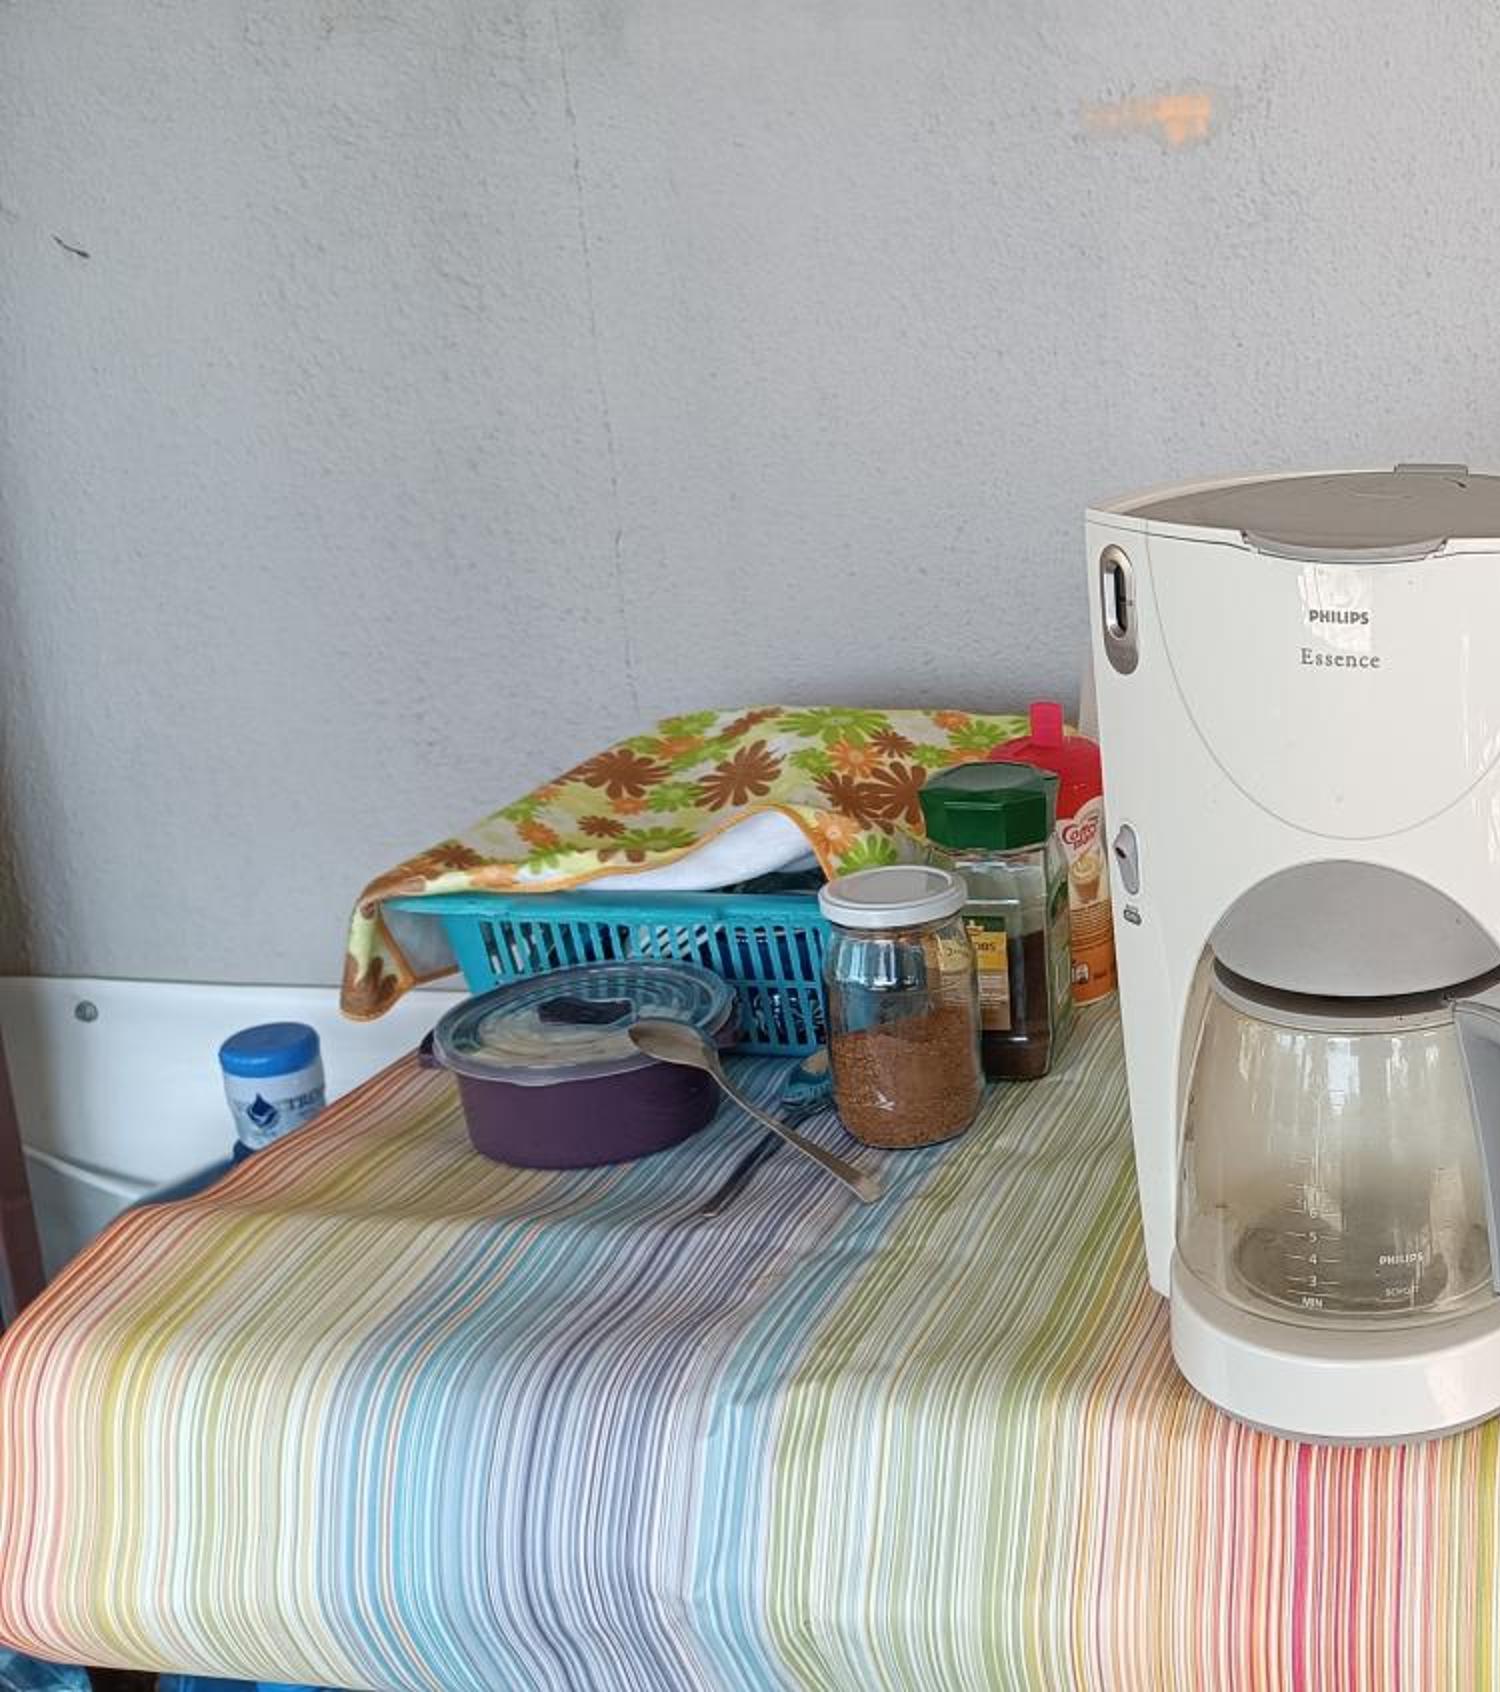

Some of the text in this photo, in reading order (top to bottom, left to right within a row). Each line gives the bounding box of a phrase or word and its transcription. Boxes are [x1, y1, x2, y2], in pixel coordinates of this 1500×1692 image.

[1308, 608, 1369, 625] PHILIPS
[1300, 647, 1381, 668] Essence
[1309, 1231, 1318, 1243] 5
[1309, 1253, 1318, 1265] 4
[1379, 1251, 1424, 1265] PHILIPS
[1309, 1275, 1318, 1287] 3
[1302, 1296, 1323, 1308] MIN
